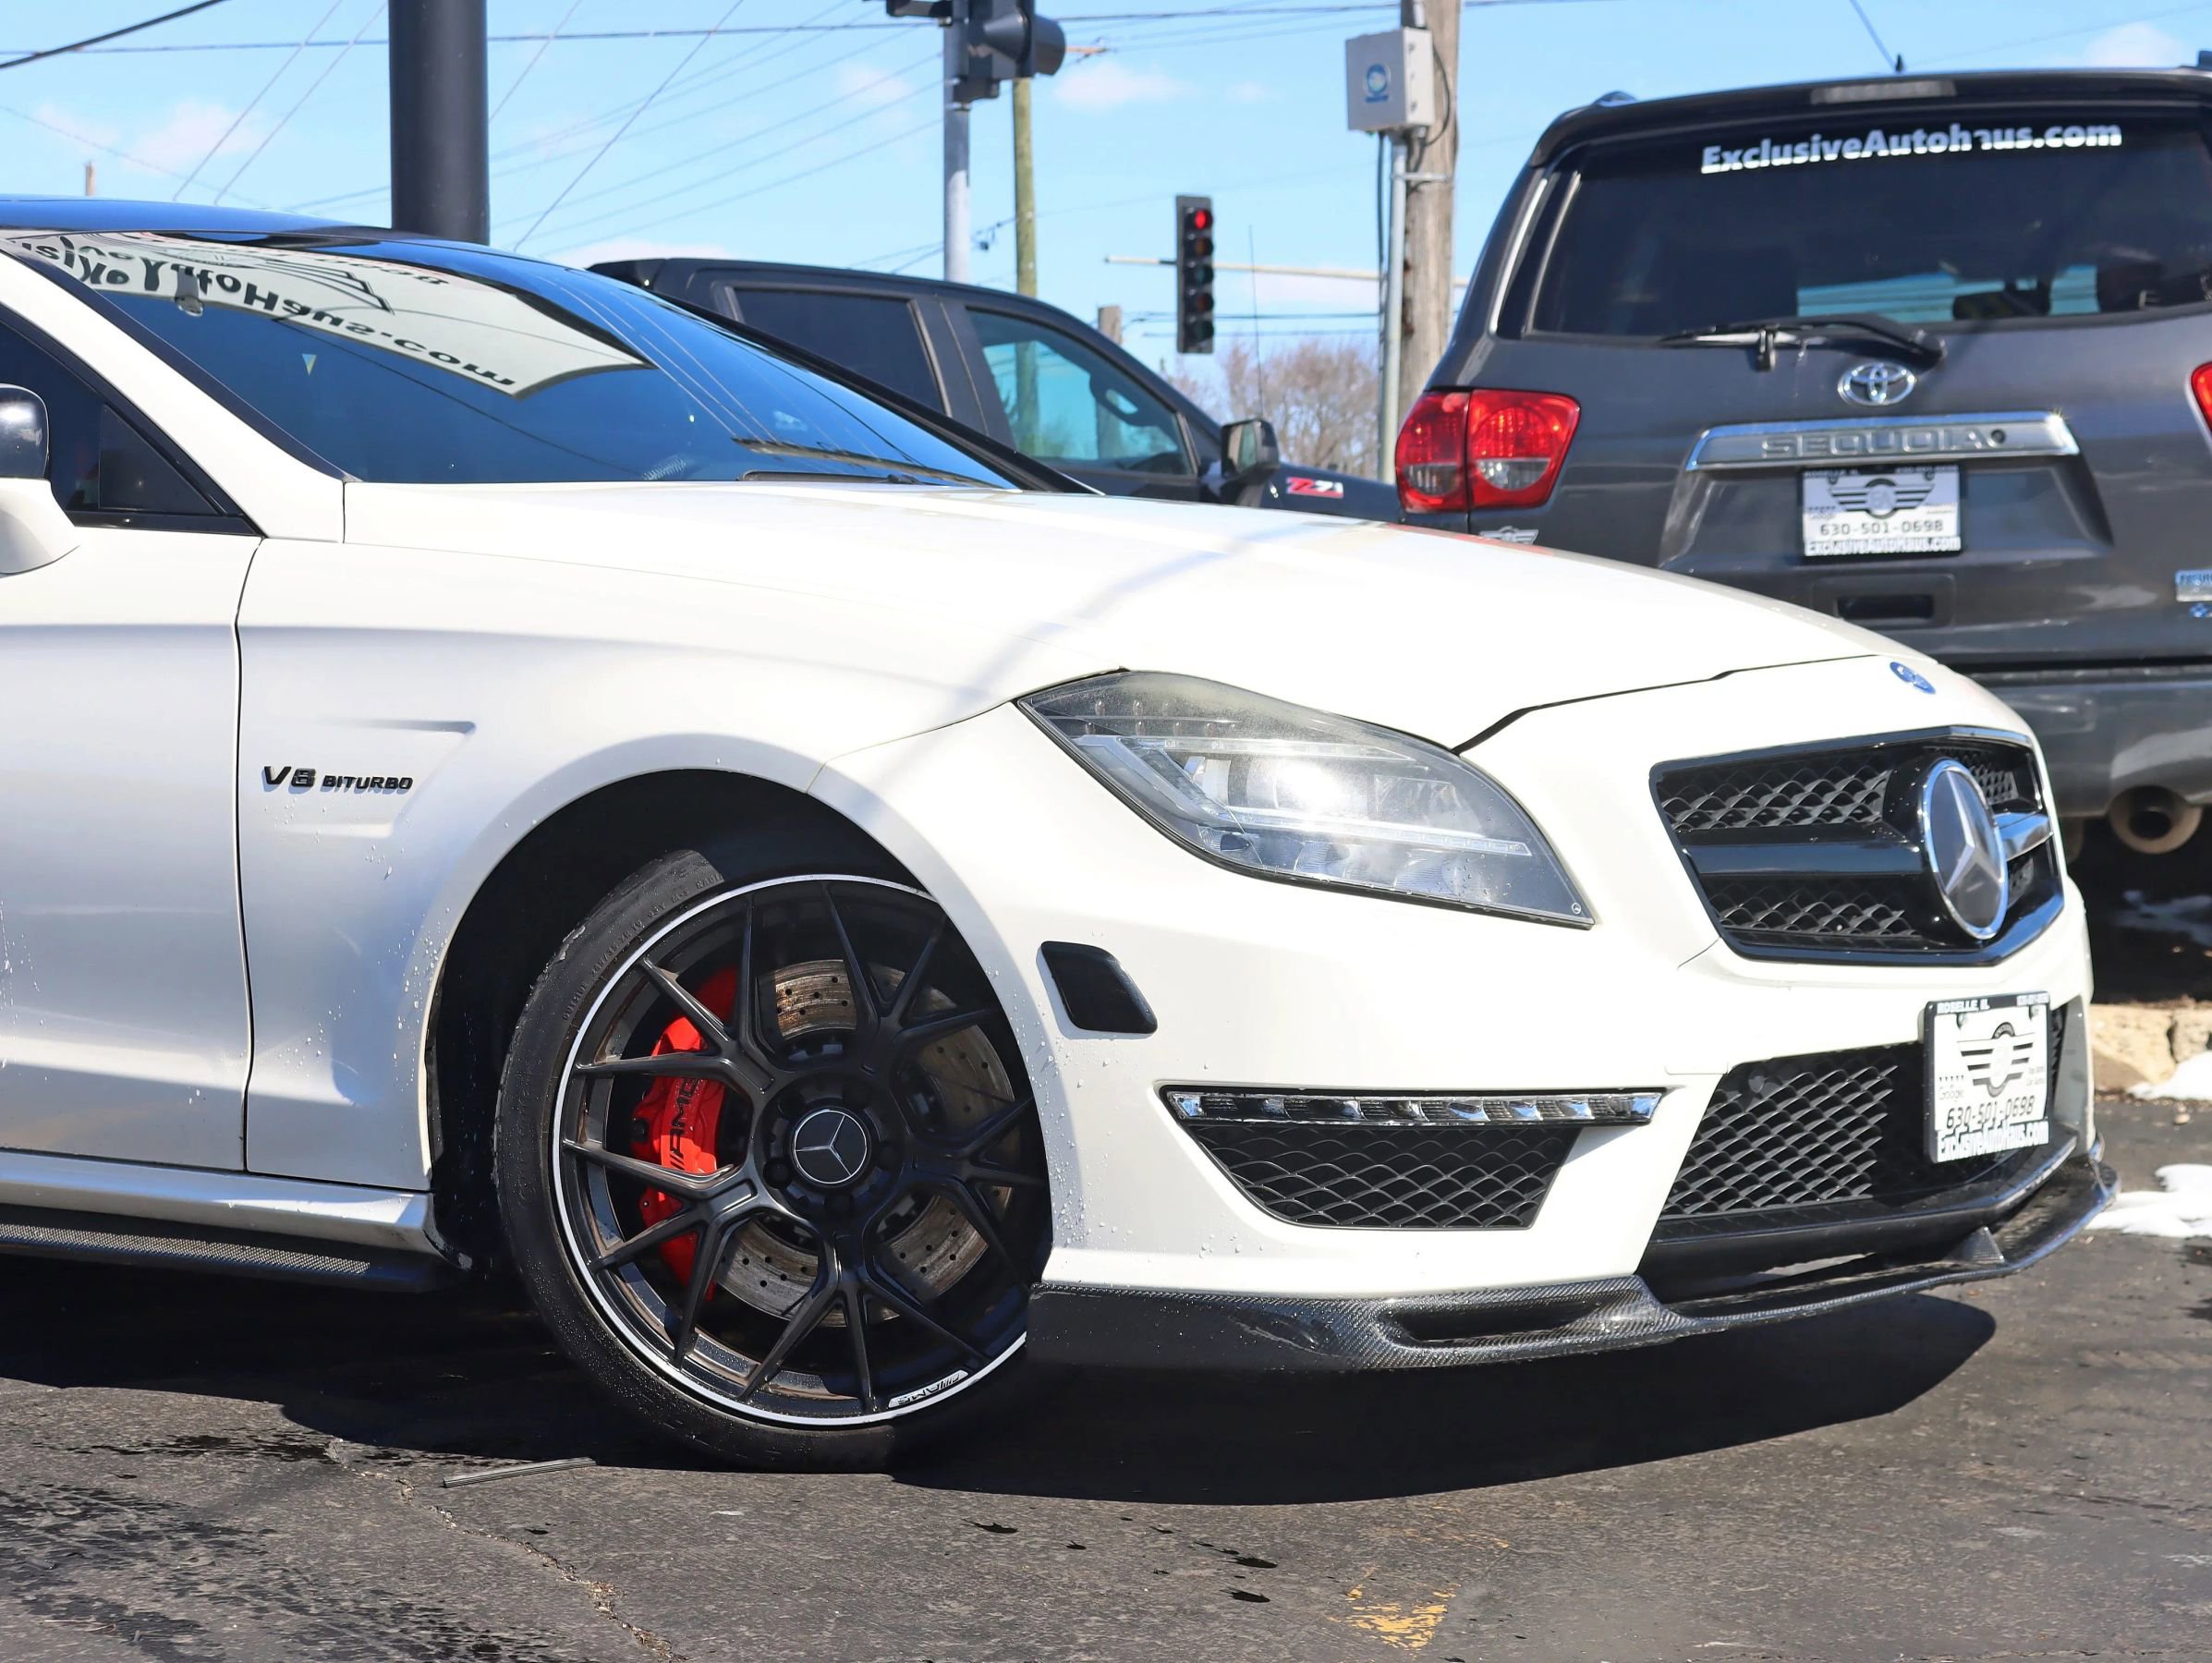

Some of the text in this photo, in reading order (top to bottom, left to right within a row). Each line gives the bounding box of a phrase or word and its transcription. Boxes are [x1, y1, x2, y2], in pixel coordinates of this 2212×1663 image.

[1761, 428, 1987, 459] SEQUOIA
[1286, 476, 1344, 499] Z71
[1820, 519, 1944, 536] 630-501-0698
[263, 765, 414, 790] V8 BITURBO
[1946, 1095, 2036, 1129] 630-501-0698
